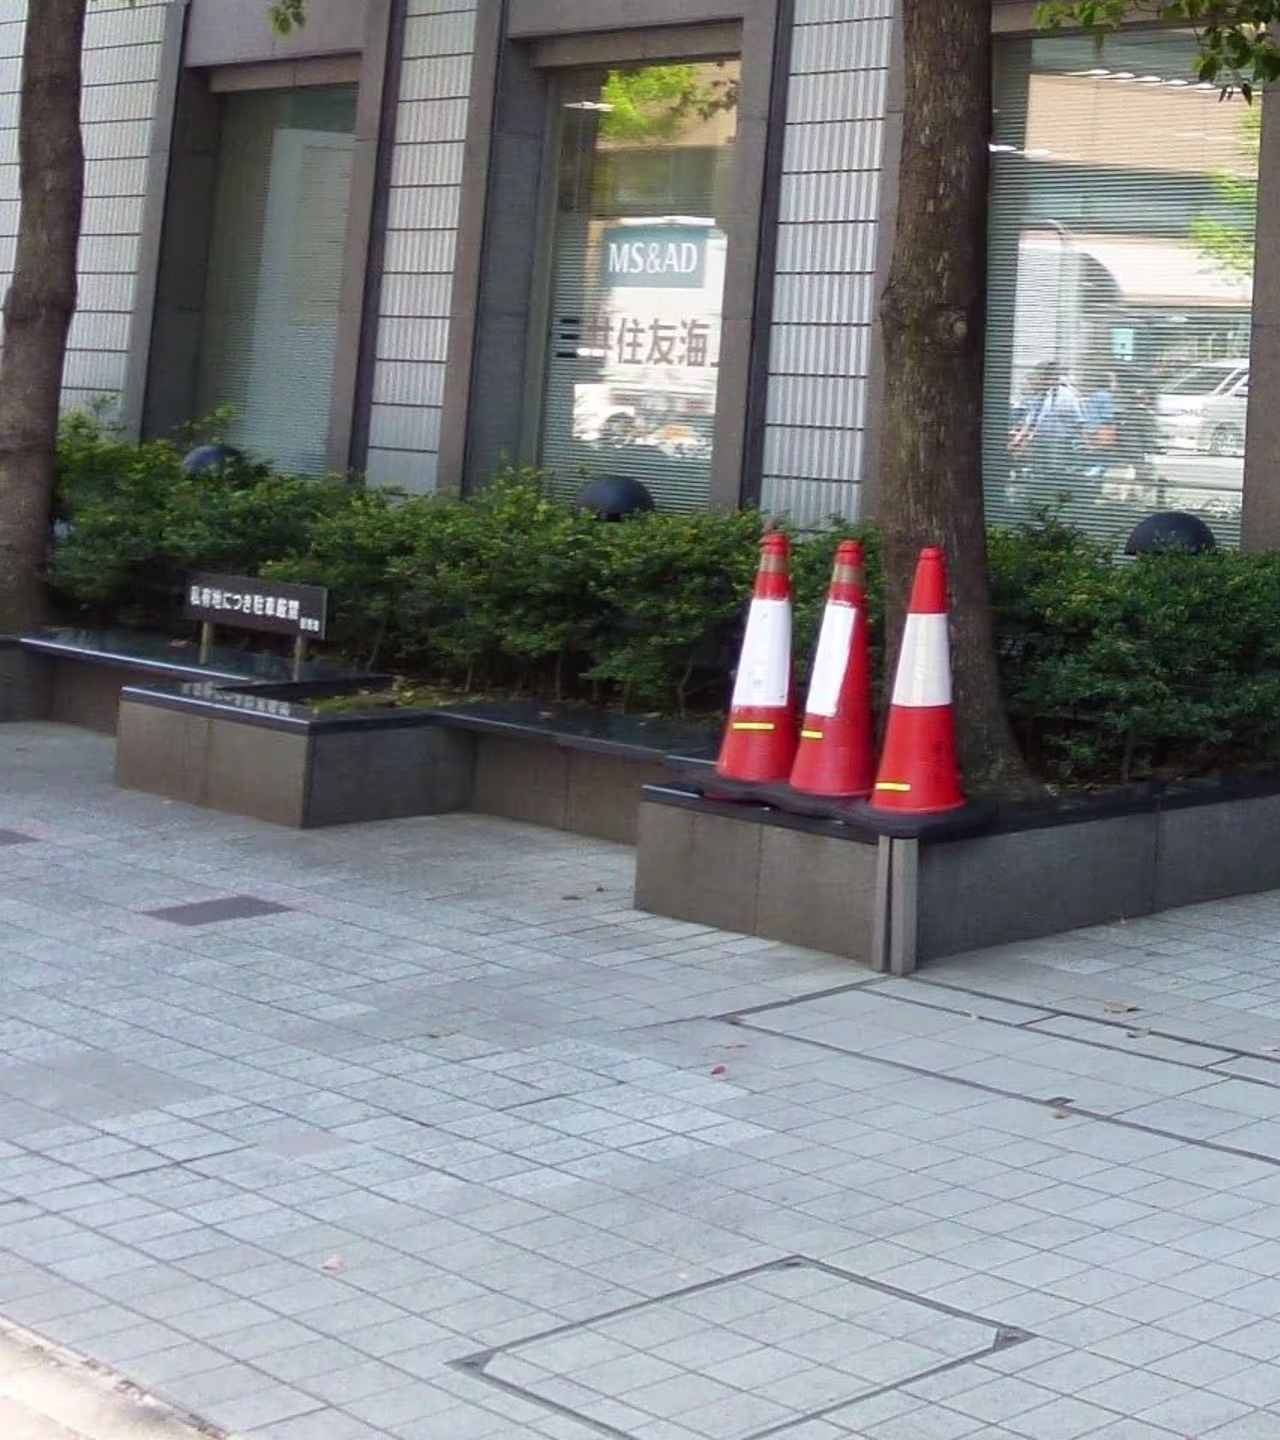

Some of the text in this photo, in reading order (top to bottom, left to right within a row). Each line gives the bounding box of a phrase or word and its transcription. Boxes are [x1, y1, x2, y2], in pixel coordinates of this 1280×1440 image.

[609, 242, 697, 273] MS&AD
[556, 318, 719, 367] 三井住友海
